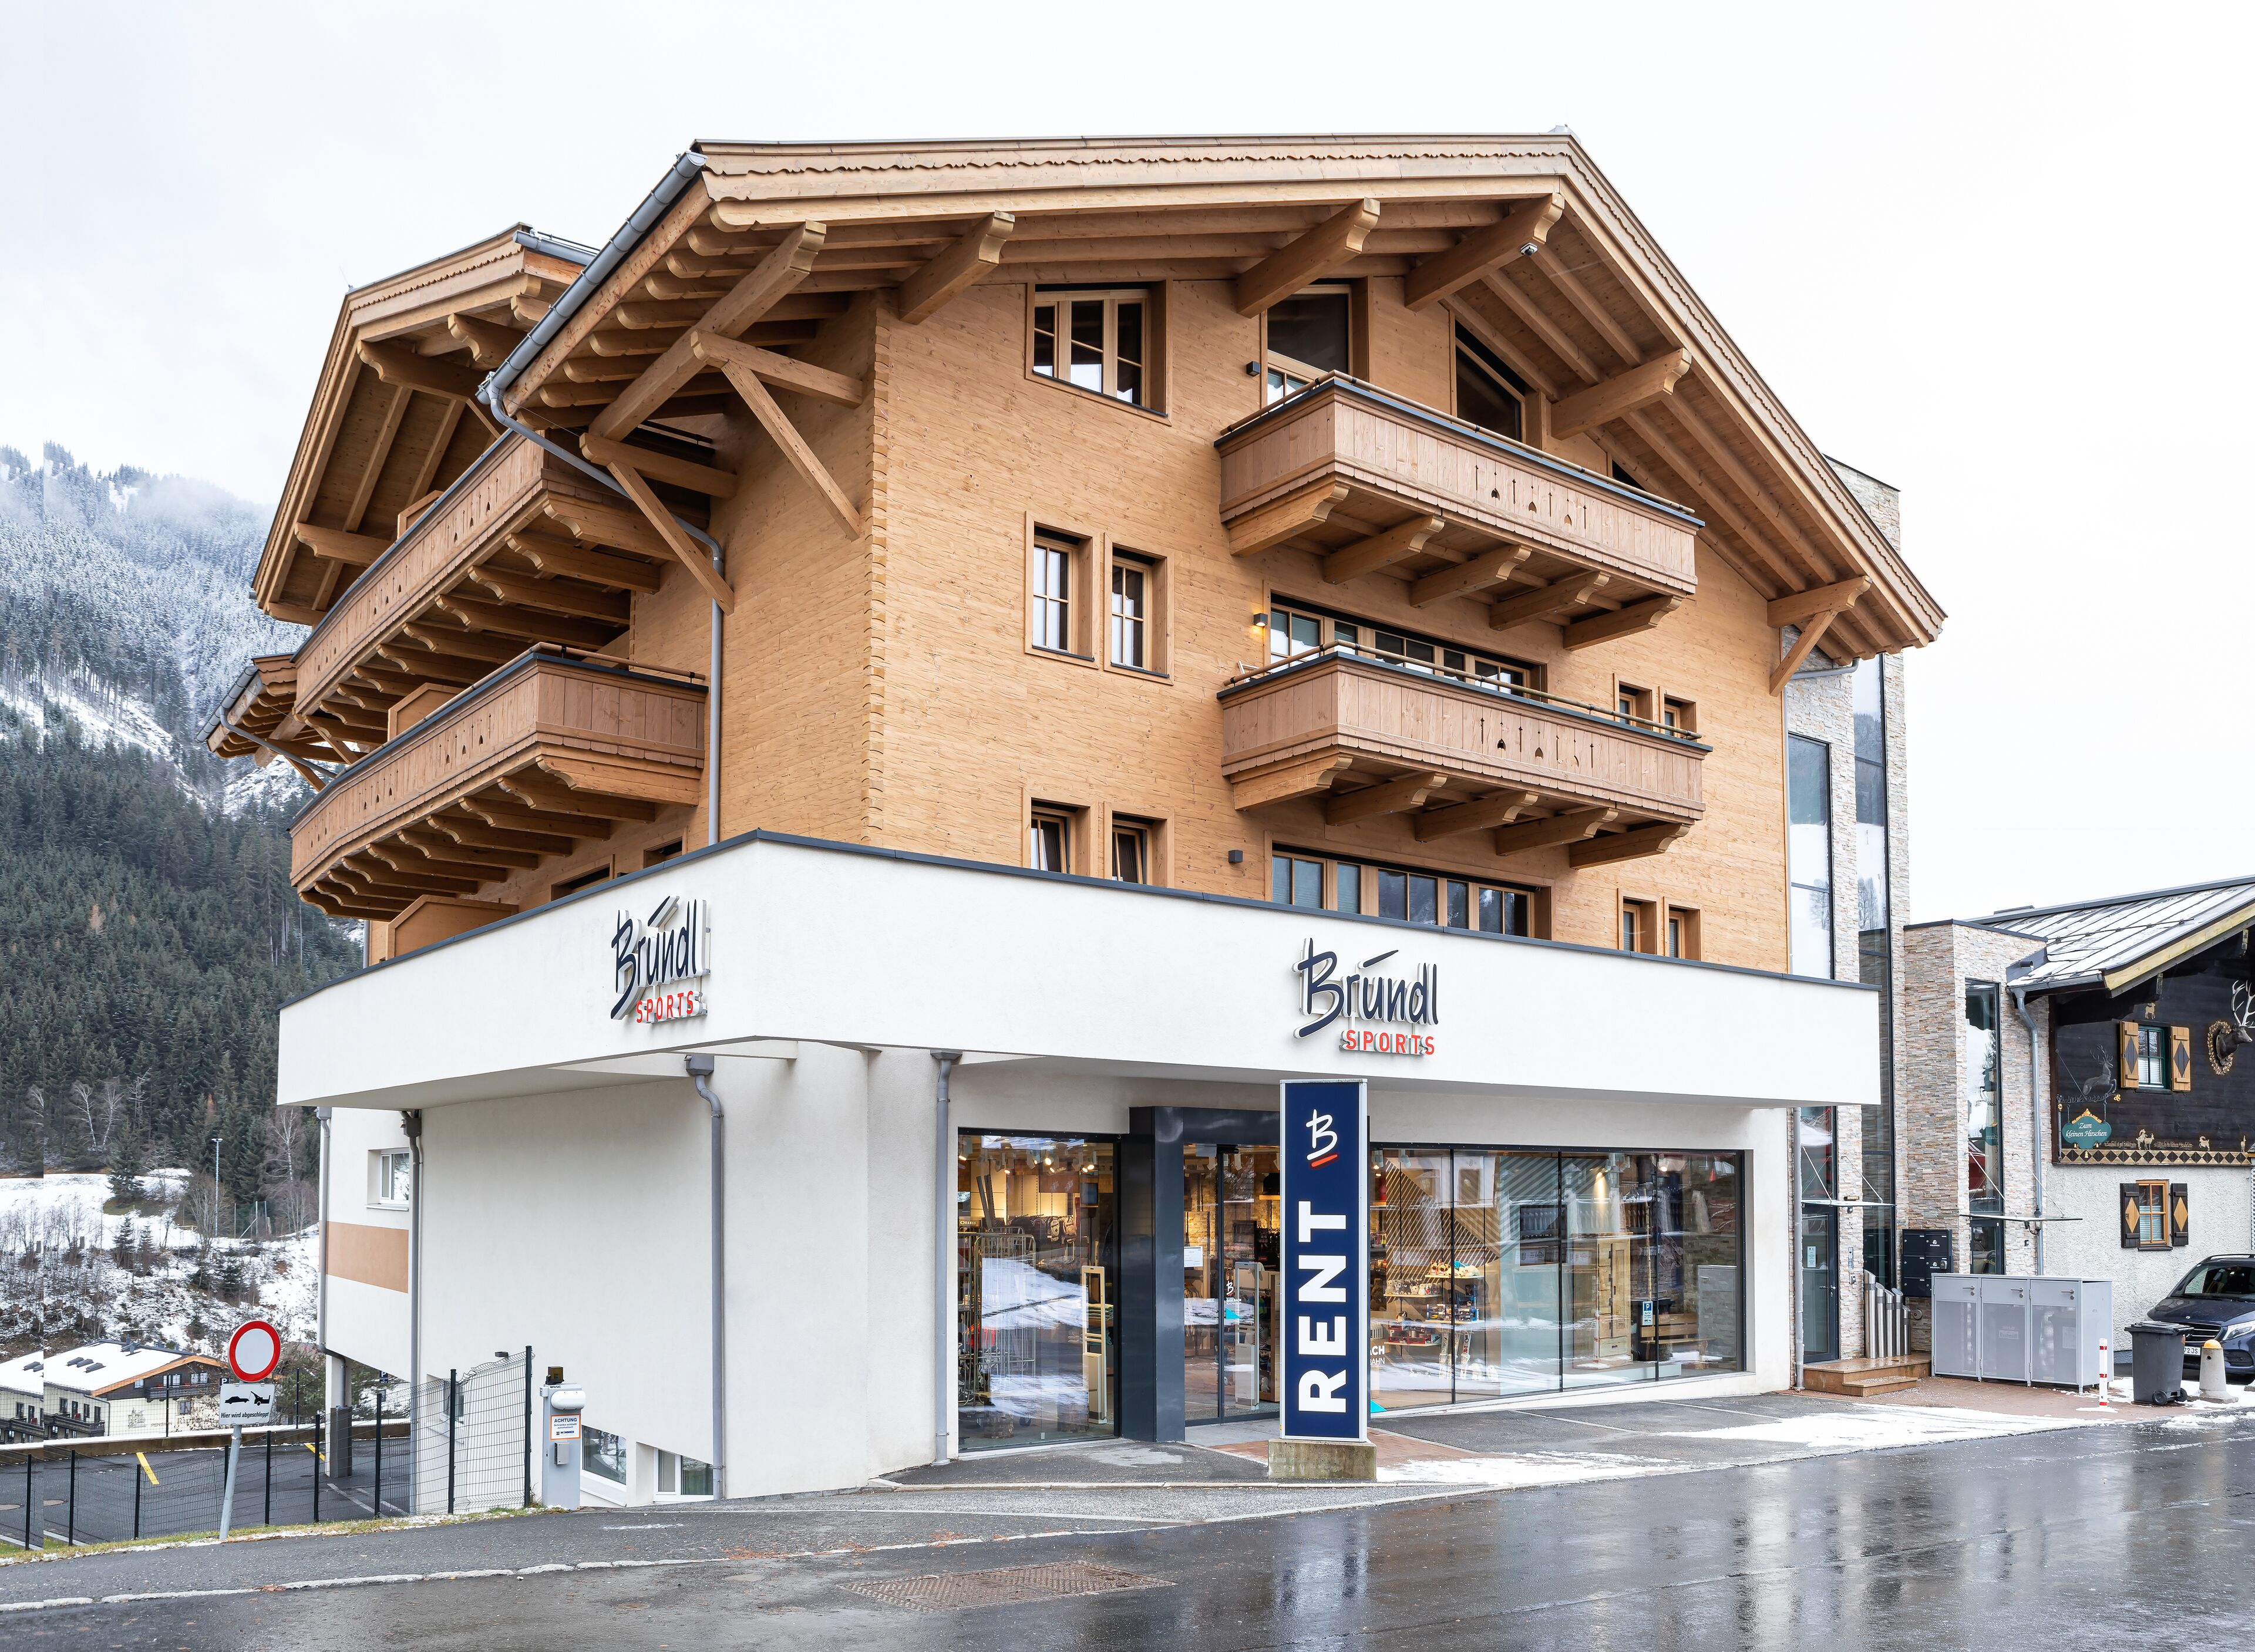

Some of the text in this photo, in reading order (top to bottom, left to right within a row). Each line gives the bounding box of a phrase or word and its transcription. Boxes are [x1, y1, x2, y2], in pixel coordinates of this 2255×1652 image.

[637, 990, 694, 1023] SPORTS
[1346, 1029, 1435, 1055] SPORTS
[1305, 1109, 1338, 1161] B
[2065, 1129, 2107, 1138] kleinen Hirschen
[1298, 1201, 1347, 1413] RENT
[1370, 1357, 1385, 1366] AHN
